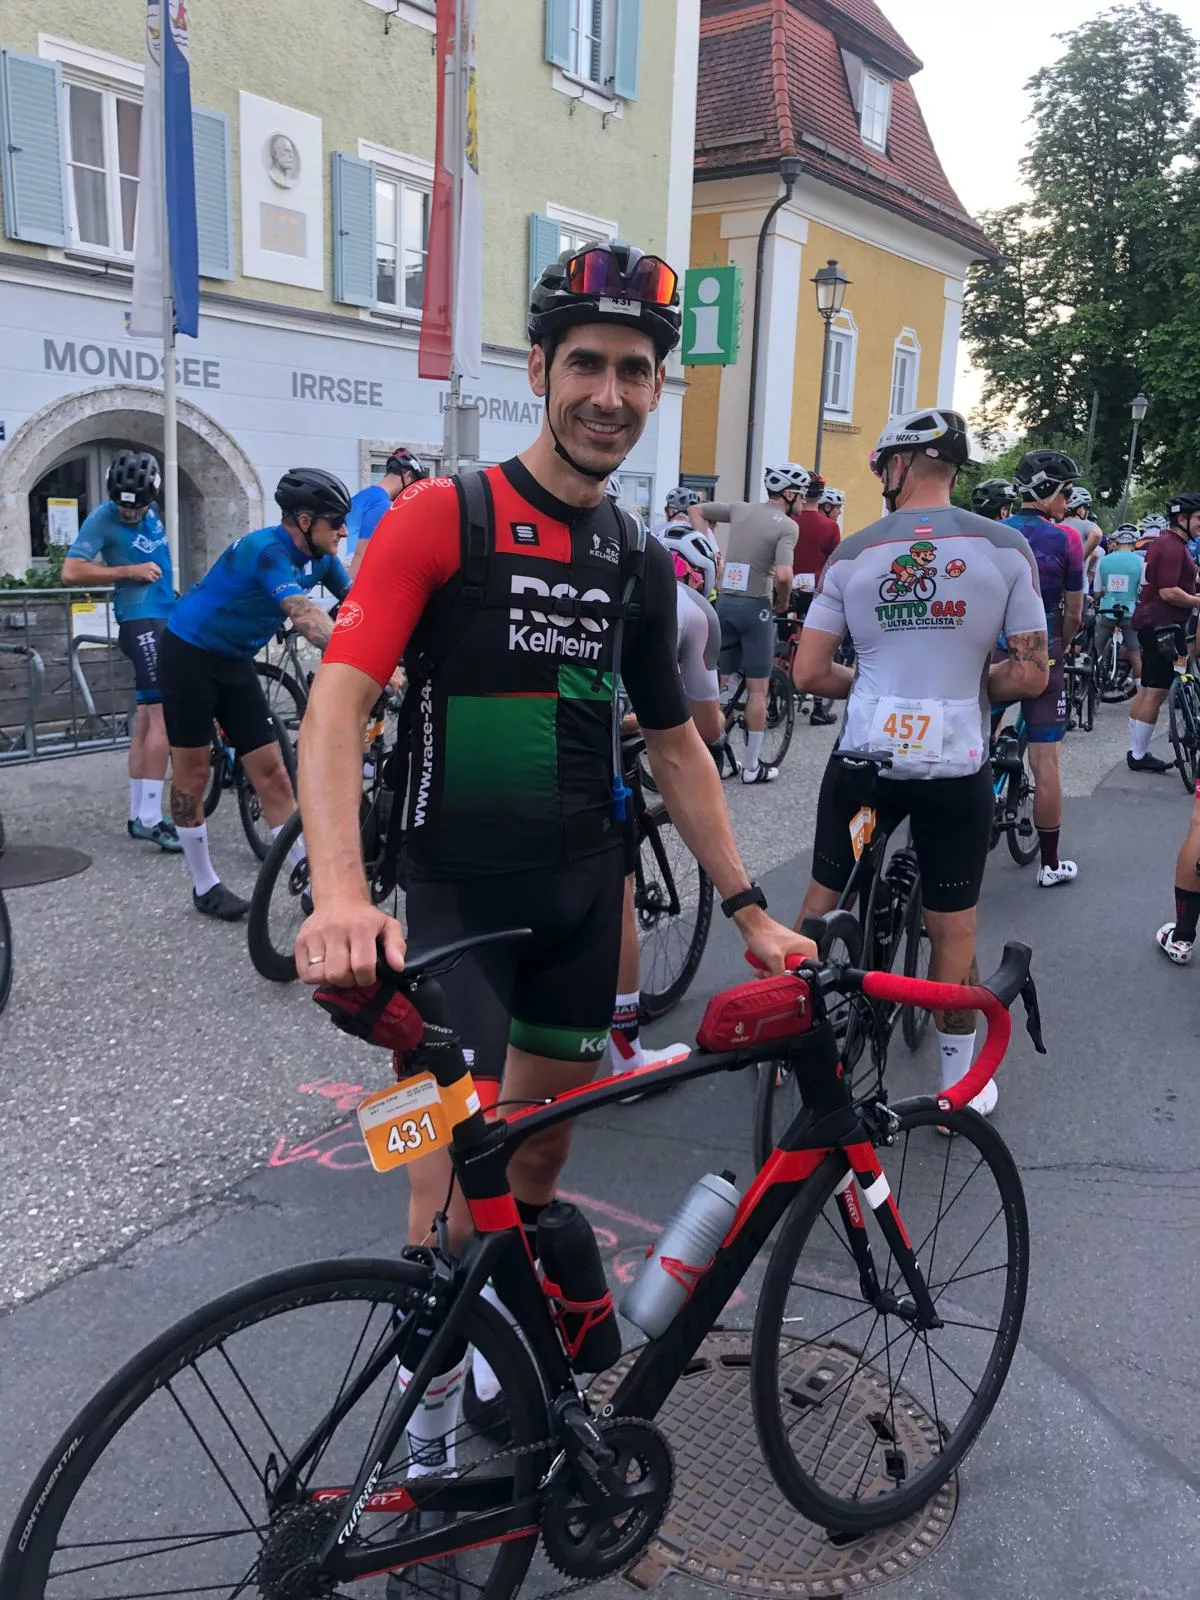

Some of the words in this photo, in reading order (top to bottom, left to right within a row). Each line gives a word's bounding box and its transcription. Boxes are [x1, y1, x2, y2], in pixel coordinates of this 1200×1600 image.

[291, 371, 384, 407] IRRSEE
[439, 391, 543, 424] IFORMAT
[589, 549, 619, 566] KELHEIM
[605, 548, 620, 560] RSC
[510, 574, 612, 633] RSC
[875, 601, 927, 620] TUTTO
[931, 600, 966, 617] GAS
[888, 618, 913, 628] ULTRA
[915, 617, 954, 626] CICLISTA
[508, 624, 603, 661] Kelheim
[883, 712, 931, 741] 457
[387, 1112, 437, 1154] 431
[18, 1435, 85, 1553] CONTINENTAL
